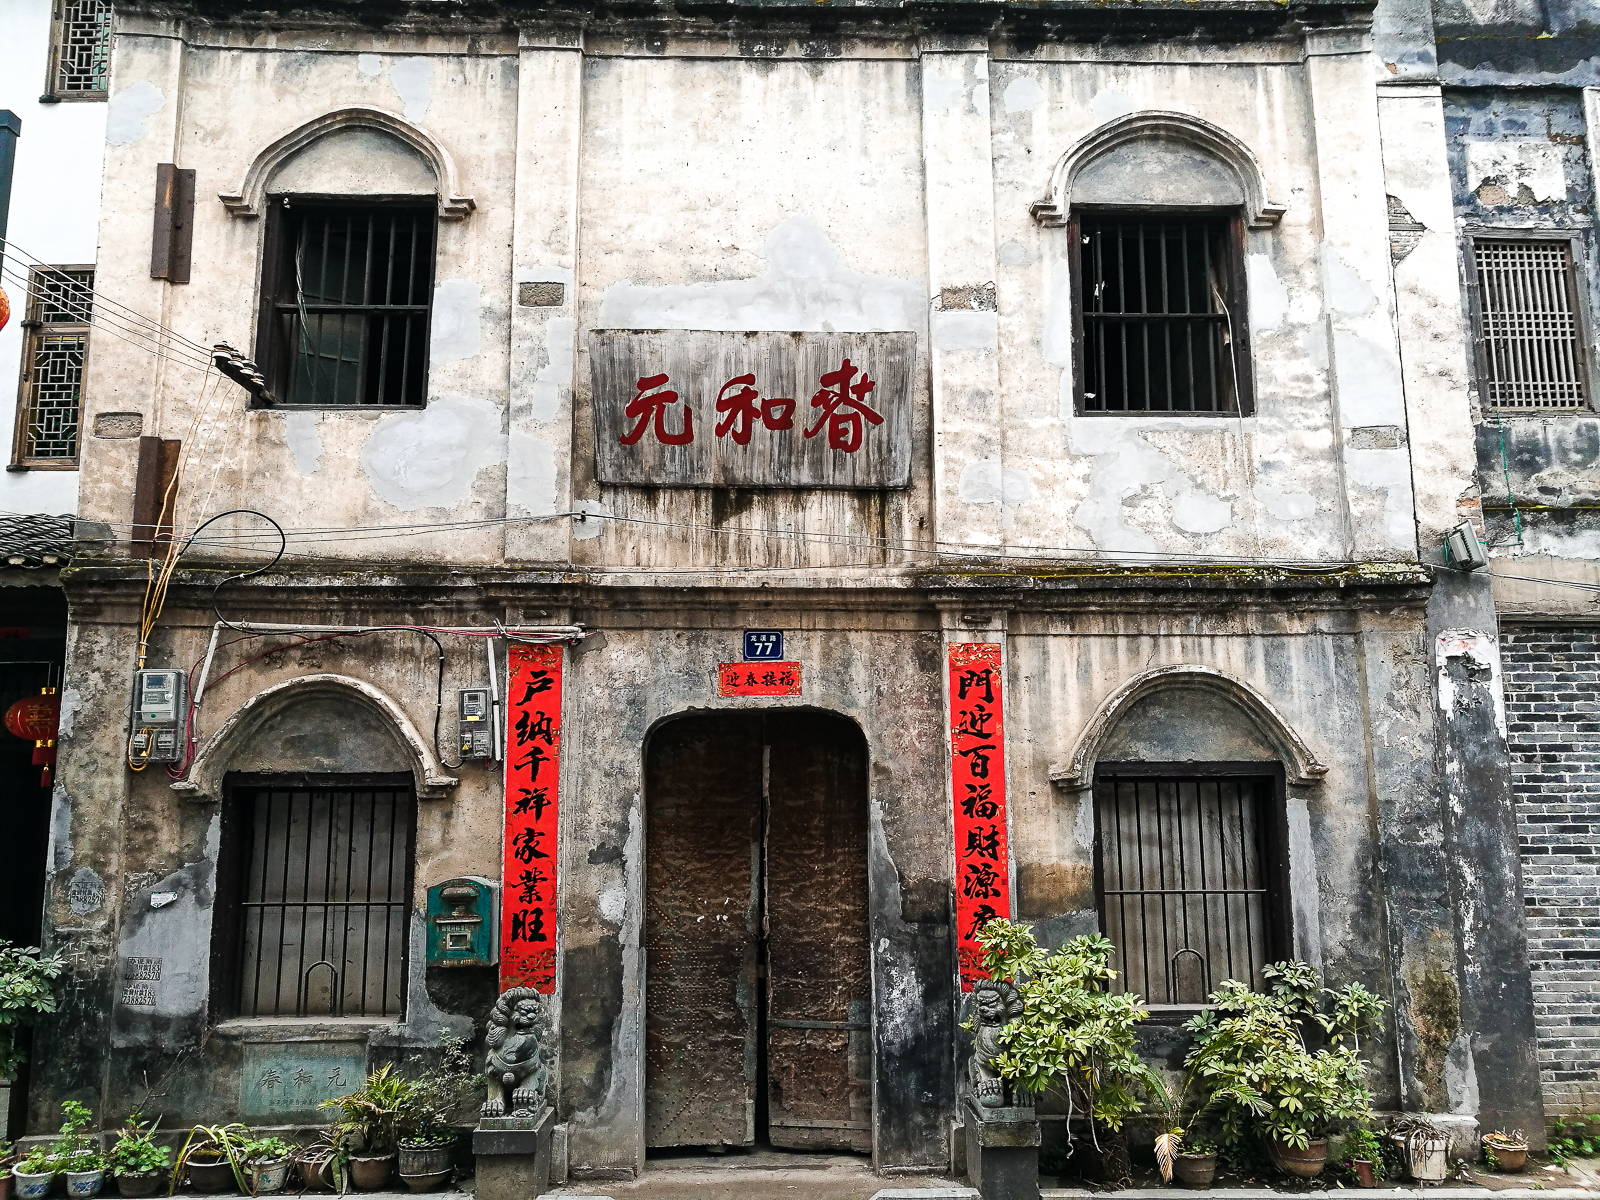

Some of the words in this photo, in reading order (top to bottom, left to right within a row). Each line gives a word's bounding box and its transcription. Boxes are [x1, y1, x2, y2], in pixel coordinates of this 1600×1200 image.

[754, 642, 773, 655] 77
[725, 671, 795, 687] 迎春接福
